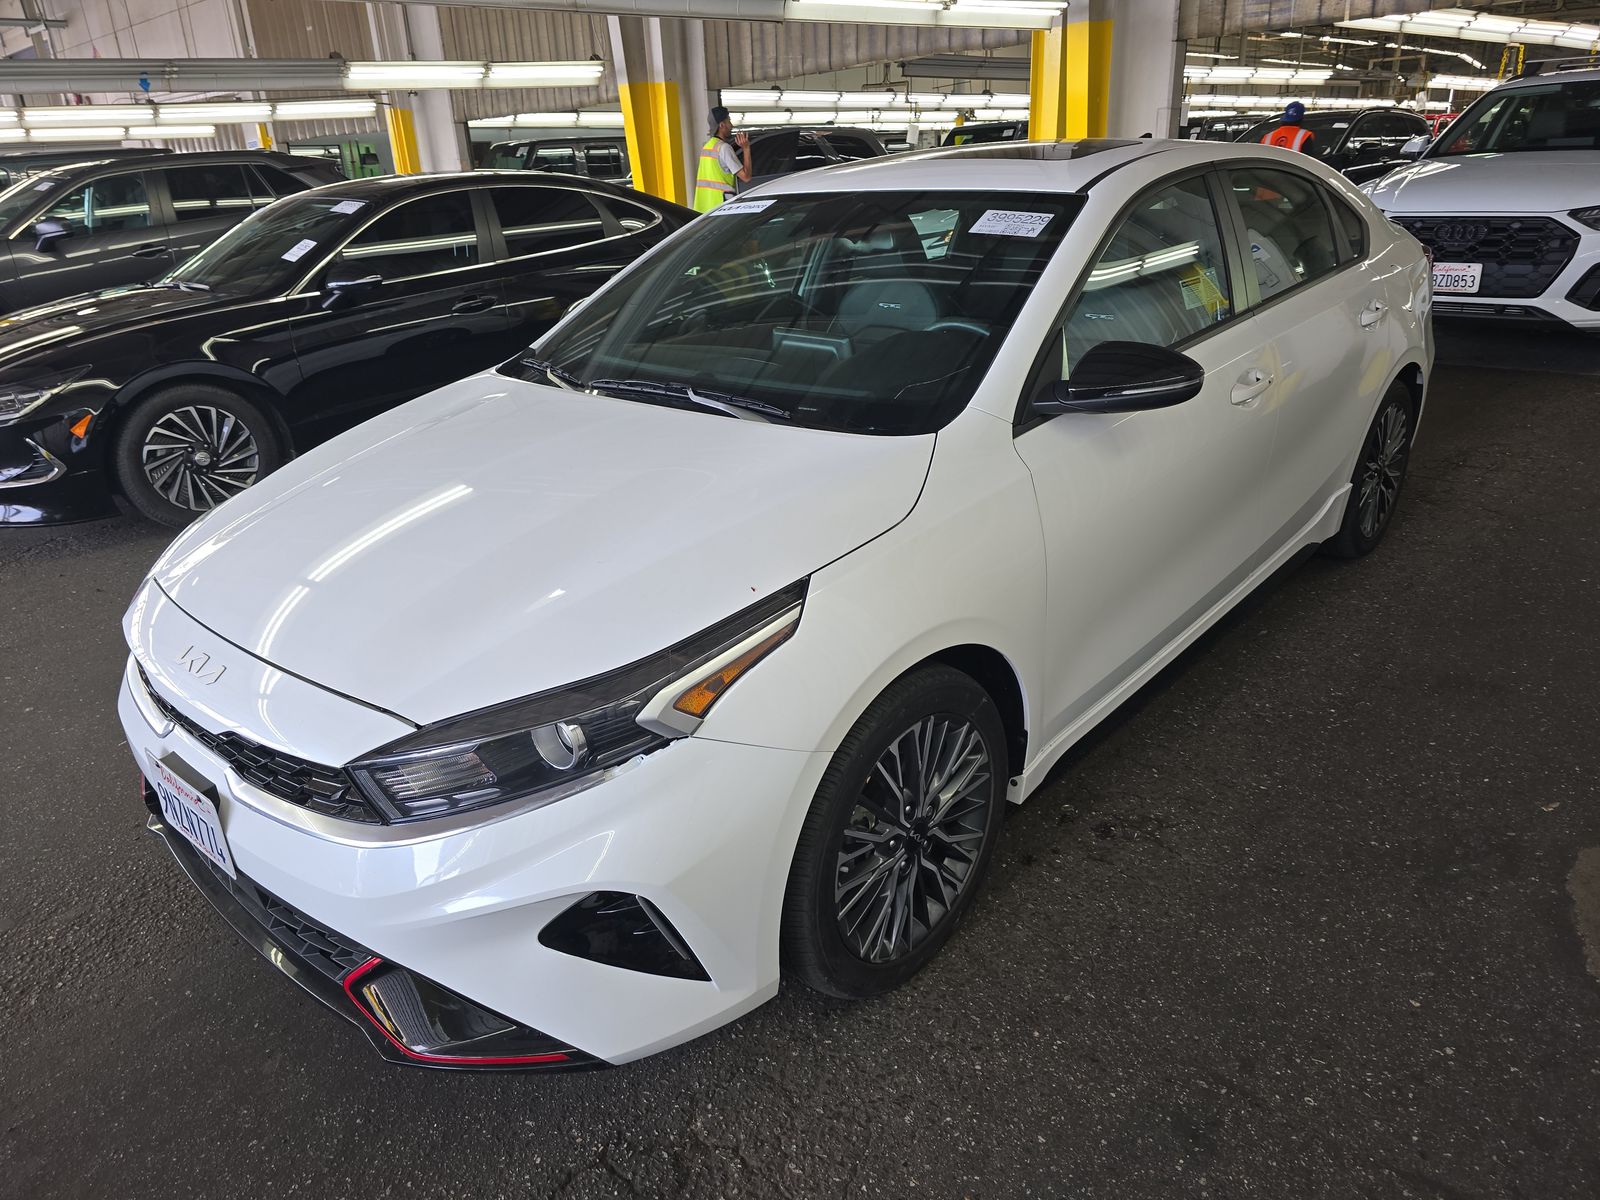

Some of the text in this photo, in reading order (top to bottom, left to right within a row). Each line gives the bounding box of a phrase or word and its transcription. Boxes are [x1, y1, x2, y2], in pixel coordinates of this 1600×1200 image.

[987, 212, 1050, 225] 3995229
[1433, 265, 1468, 273] California
[177, 645, 227, 686] KIA
[160, 764, 202, 806] California
[158, 781, 227, 864] 9NZN774
